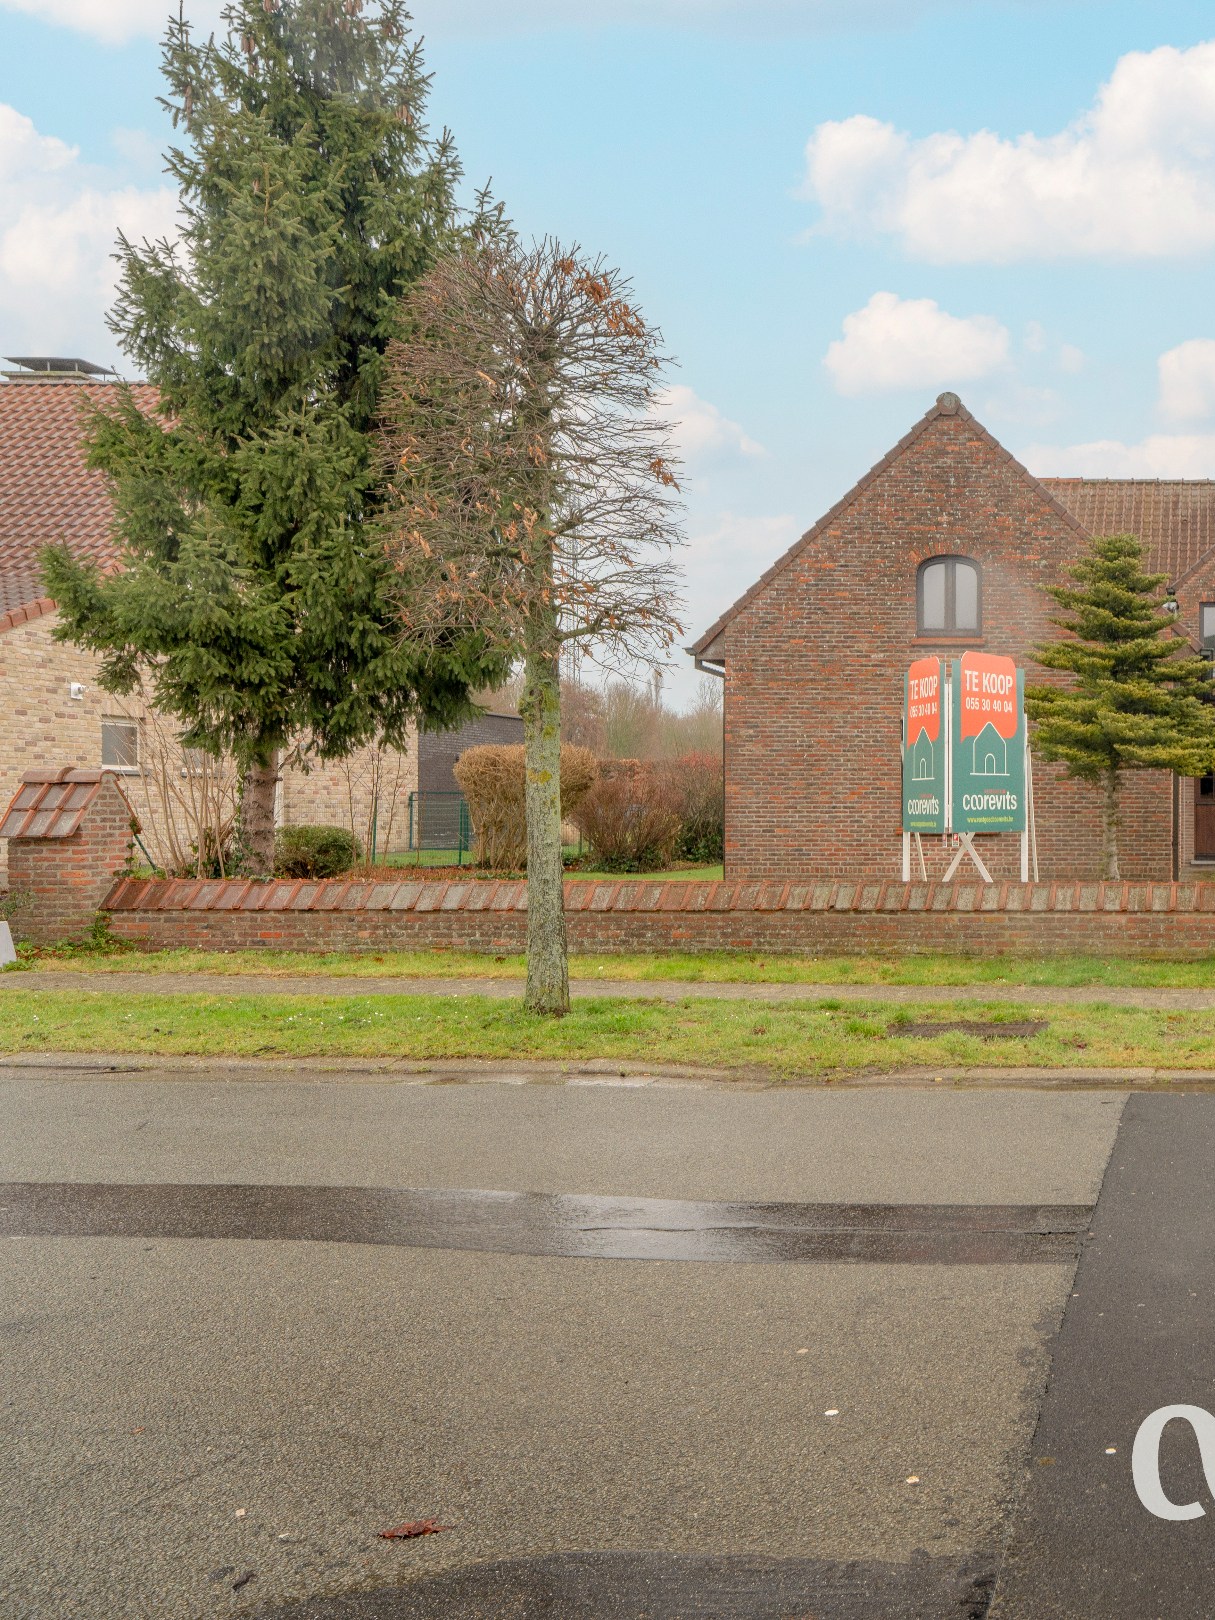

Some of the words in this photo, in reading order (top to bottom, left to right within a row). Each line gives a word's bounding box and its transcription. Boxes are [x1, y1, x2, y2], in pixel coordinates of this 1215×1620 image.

[910, 679, 918, 701] TE
[919, 675, 938, 699] KOOP
[964, 669, 979, 692] TE
[982, 672, 1013, 696] KOOP
[965, 696, 980, 710] 055
[981, 698, 991, 712] 30
[992, 700, 1002, 713] 40
[1003, 701, 1013, 713] 04
